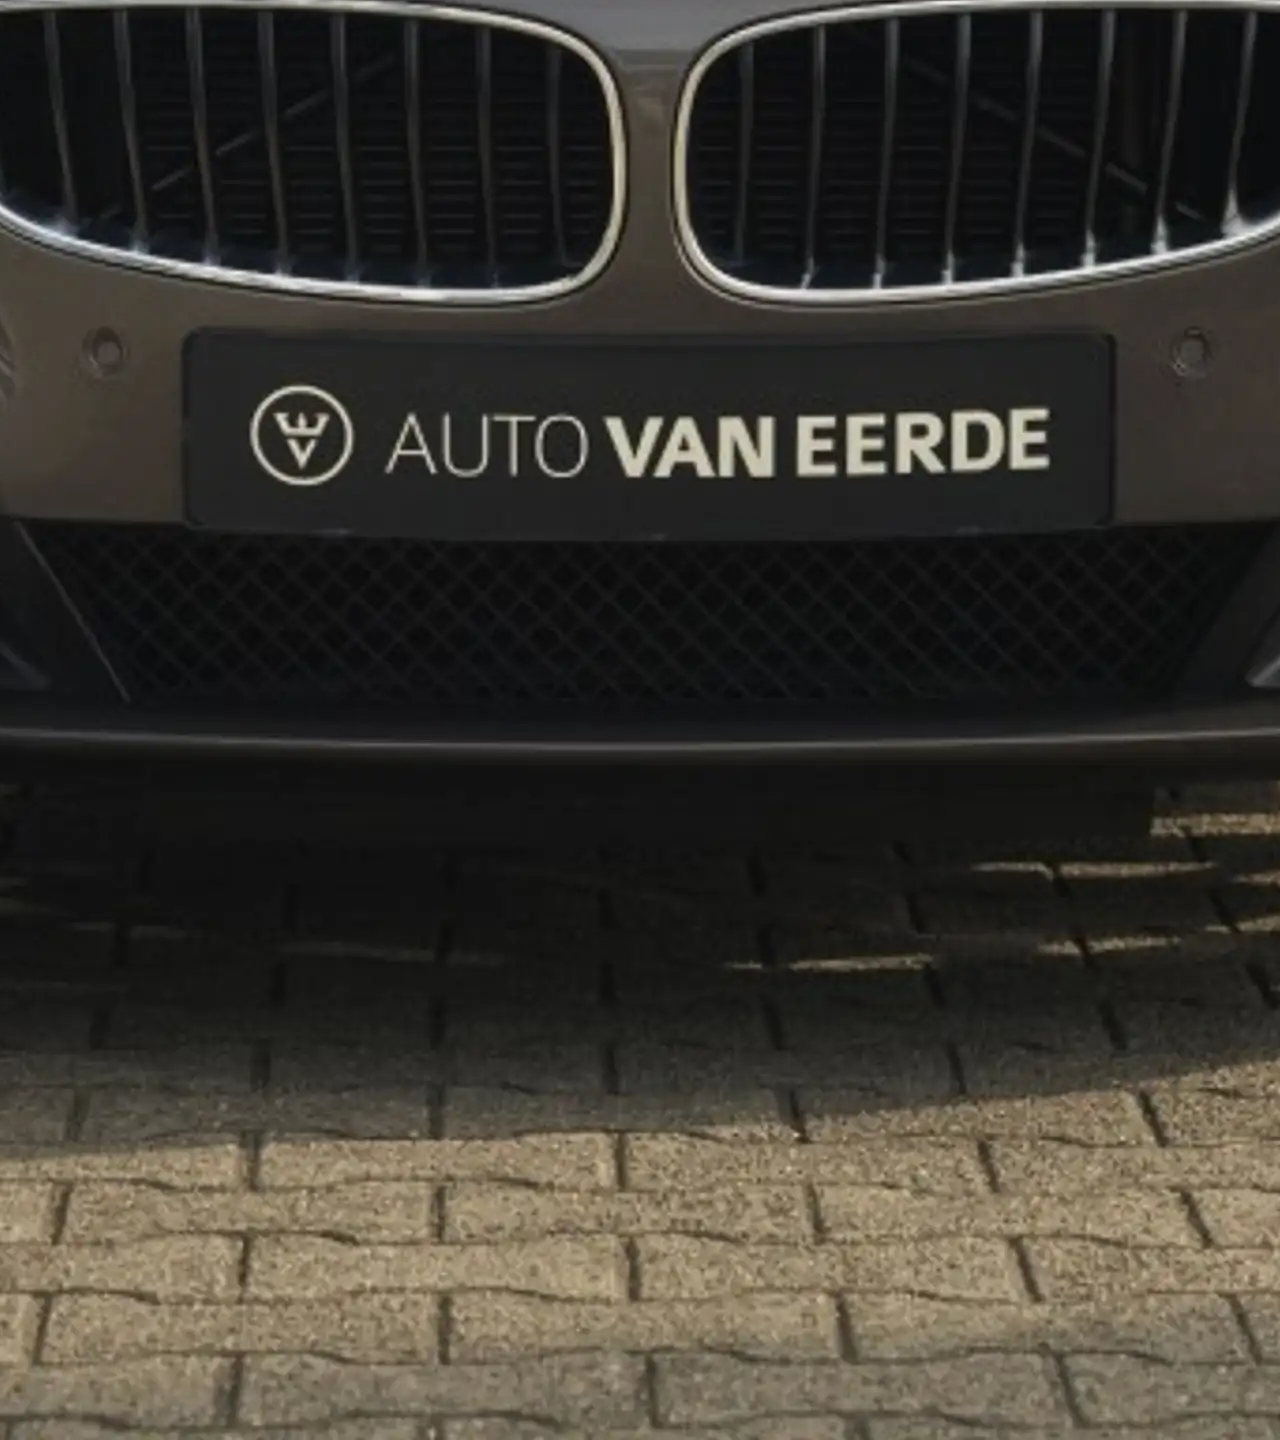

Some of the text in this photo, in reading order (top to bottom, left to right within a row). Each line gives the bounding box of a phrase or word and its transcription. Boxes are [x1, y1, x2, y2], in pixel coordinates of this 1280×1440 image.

[385, 407, 1050, 478] AUTO VAN EERDE
